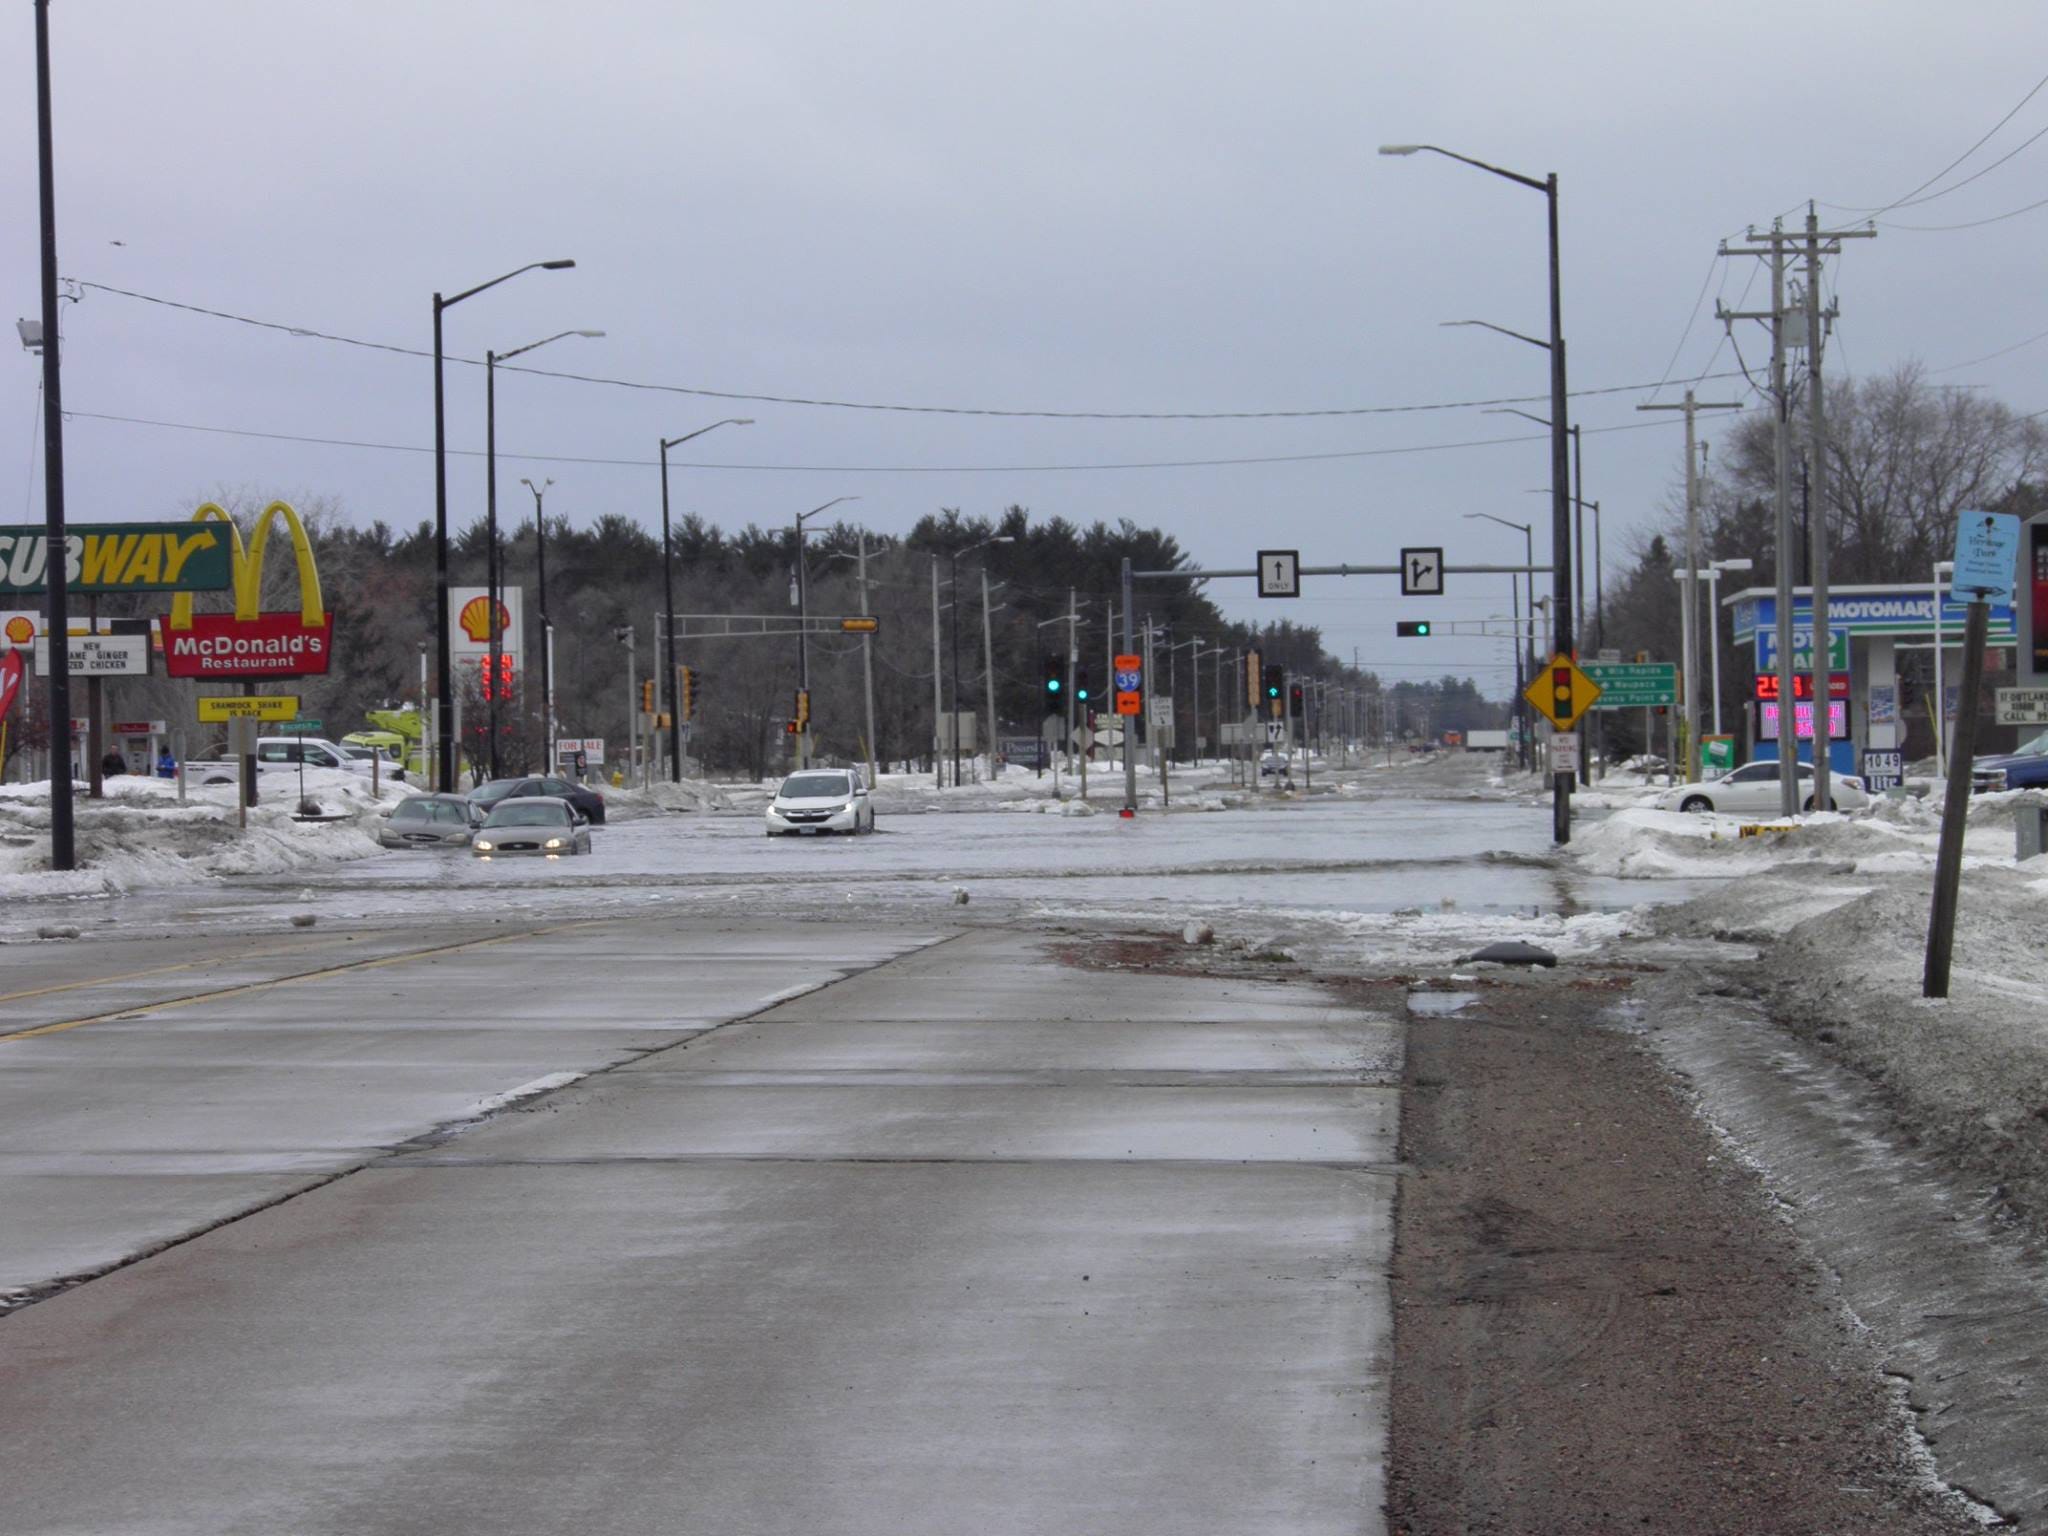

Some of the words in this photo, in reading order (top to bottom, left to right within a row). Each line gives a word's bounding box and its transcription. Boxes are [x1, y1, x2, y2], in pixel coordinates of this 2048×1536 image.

[1268, 582, 1289, 590] ONLY
[83, 642, 101, 651] NEW
[173, 635, 323, 655] McDonald's
[97, 651, 128, 660] GINGER
[89, 660, 126, 669] CHICKEN
[201, 655, 295, 669] Restaurant
[1119, 673, 1138, 688] 39
[2003, 711, 2026, 721] CALL
[559, 741, 577, 750] FOR
[581, 741, 602, 750] ALE
